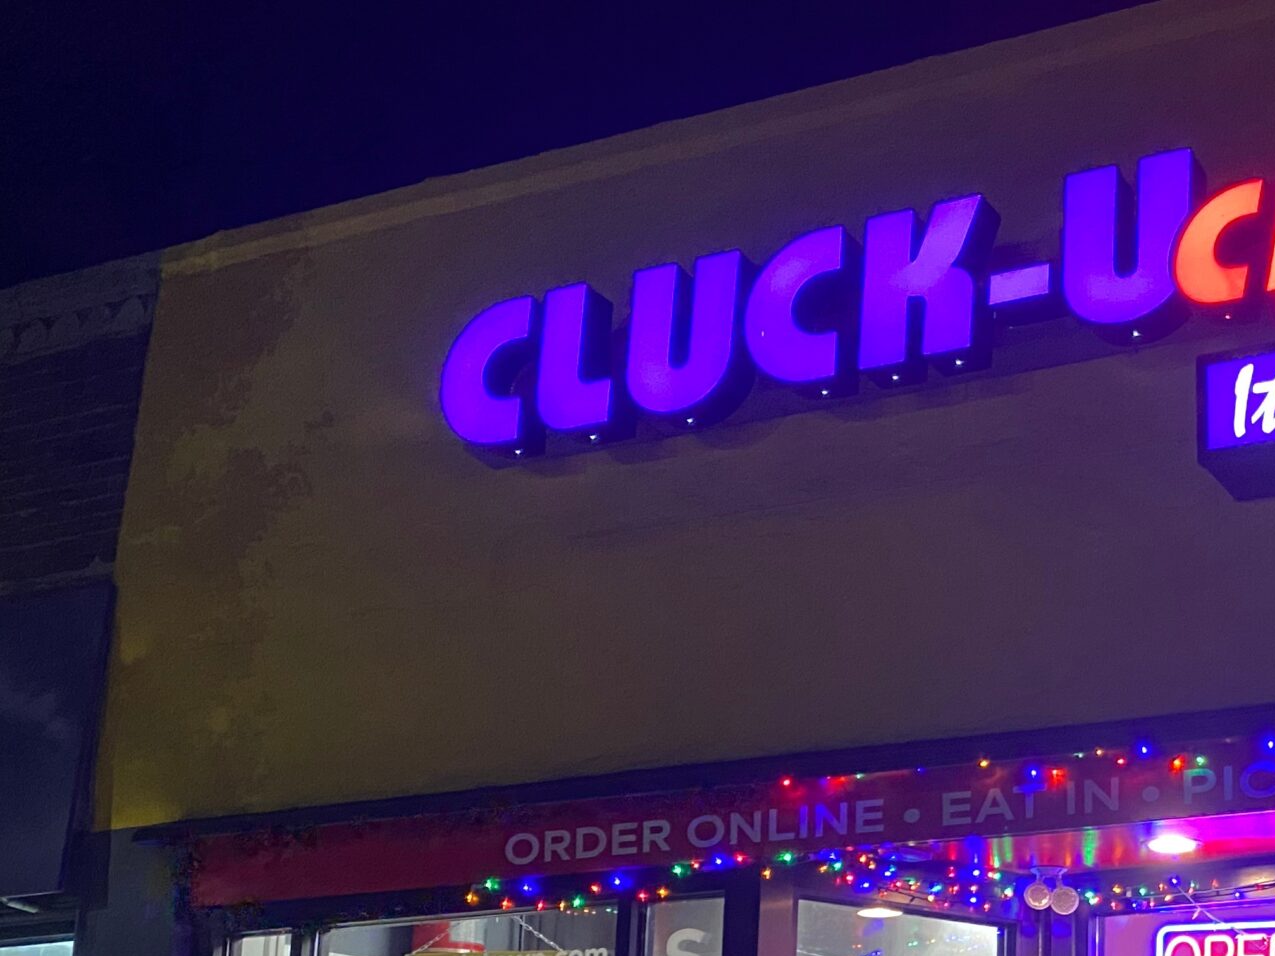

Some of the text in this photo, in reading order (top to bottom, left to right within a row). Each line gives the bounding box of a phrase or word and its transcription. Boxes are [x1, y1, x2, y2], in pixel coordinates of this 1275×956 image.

[440, 148, 1193, 445] CLUCK-U
[505, 818, 671, 866] ORDER
[686, 799, 885, 850] ONLINE
[941, 785, 1041, 828] EAT
[1066, 777, 1121, 816] IN
